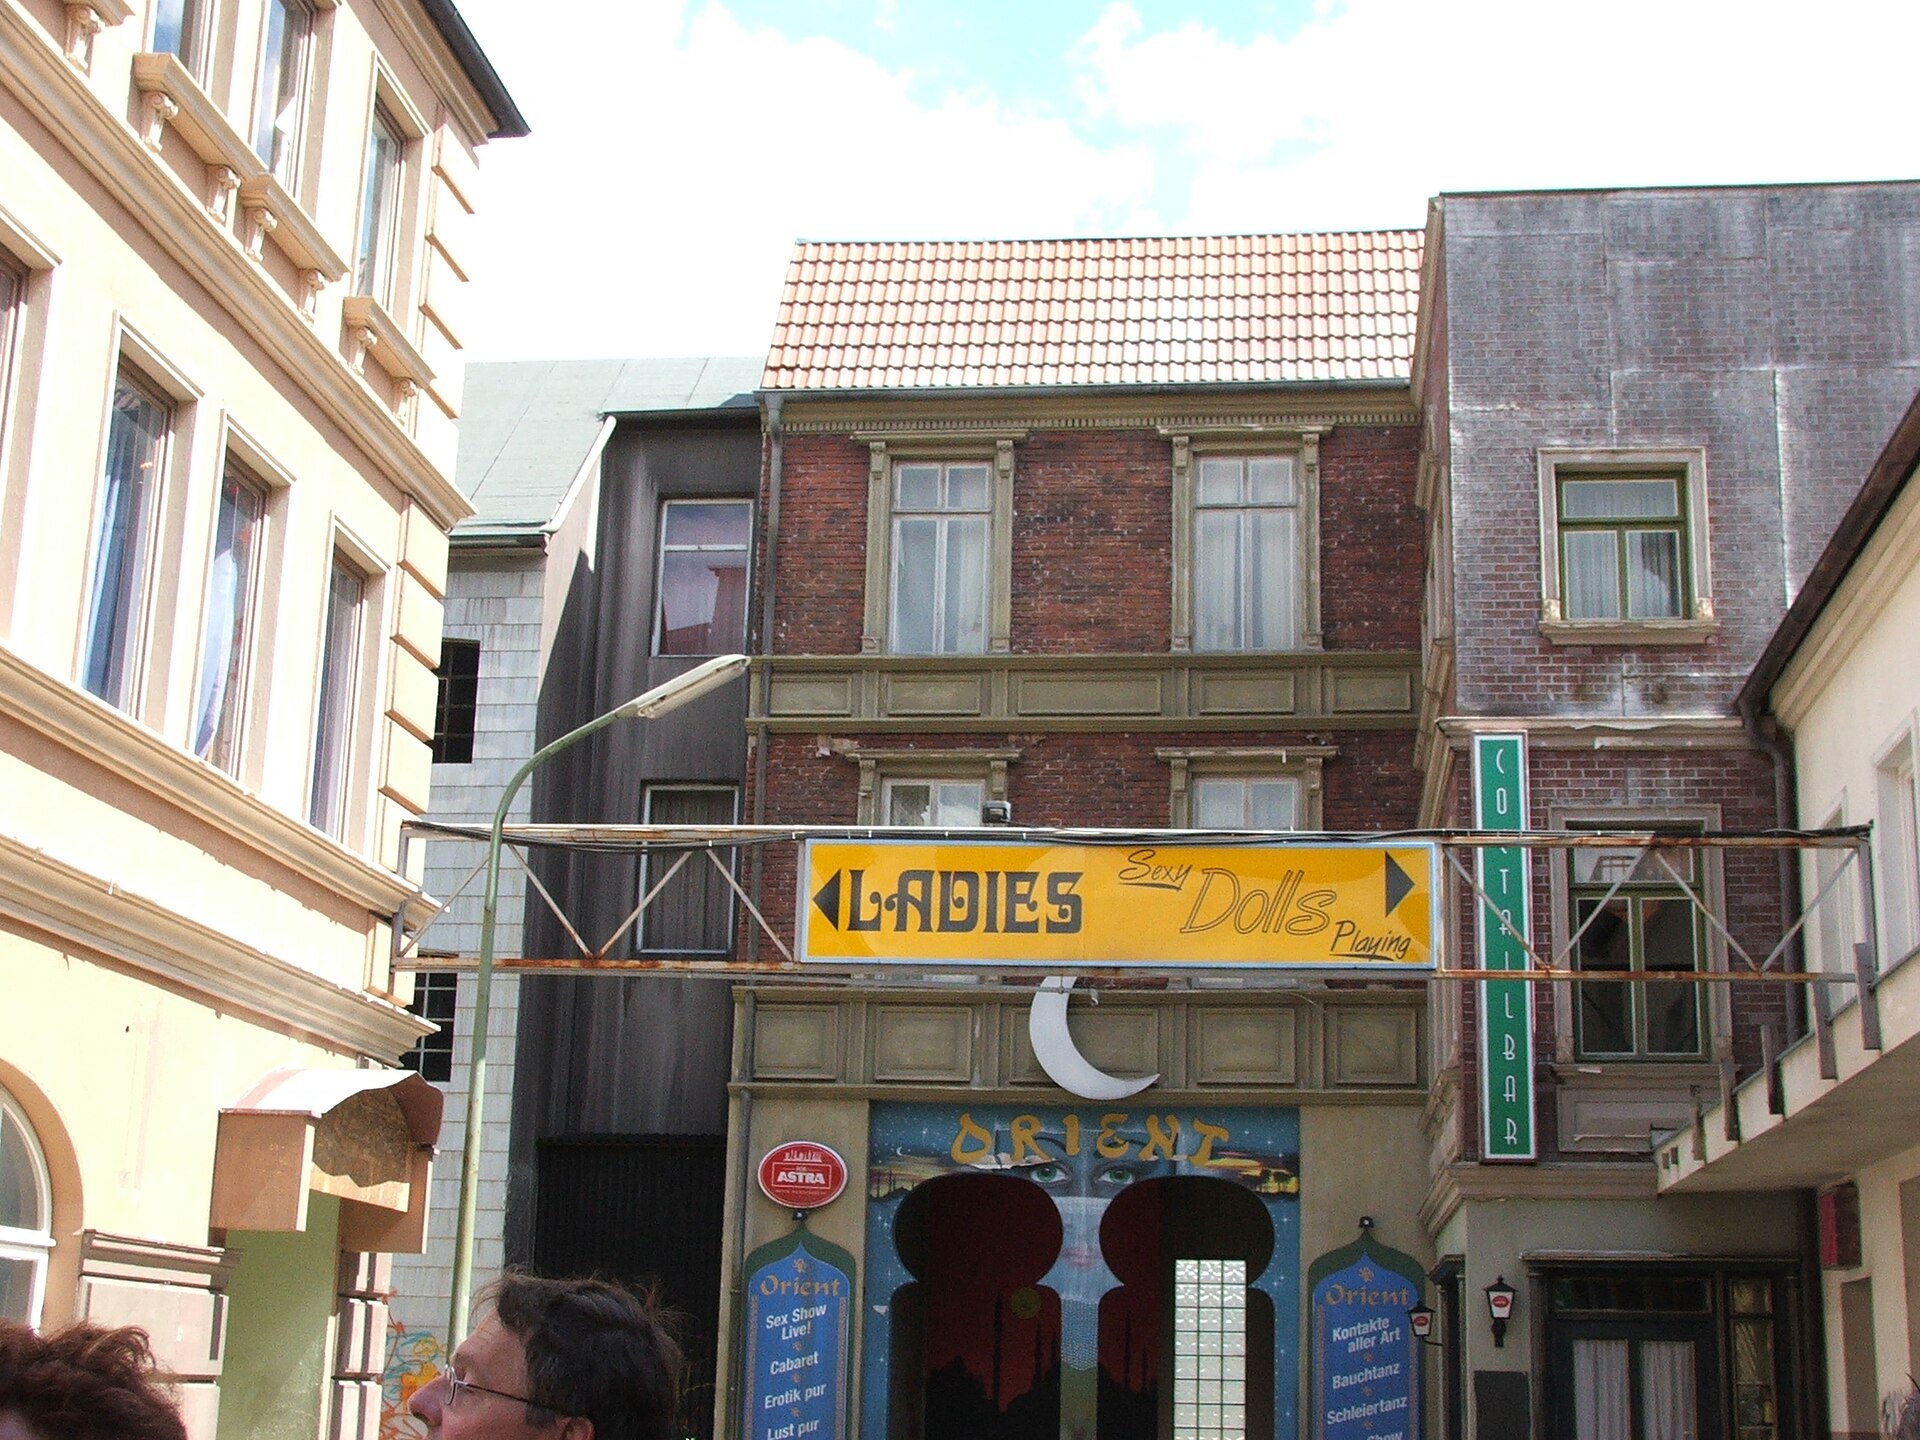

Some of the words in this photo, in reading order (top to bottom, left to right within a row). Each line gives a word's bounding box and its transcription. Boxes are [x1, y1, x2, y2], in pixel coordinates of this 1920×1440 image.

[1118, 849, 1193, 884] Sexy
[846, 869, 1084, 933] LADIES
[1180, 867, 1337, 936] Dolls
[1331, 920, 1412, 961] Playing
[1496, 748, 1518, 1145] COTAILBAR
[951, 1113, 1230, 1167] ORIENT
[777, 1171, 826, 1185] ASTRA
[760, 1274, 840, 1297] Orient
[1325, 1283, 1409, 1306] Orient
[766, 1314, 788, 1329] Sex
[792, 1304, 827, 1322] Show
[781, 1321, 811, 1340] Live!
[1332, 1317, 1390, 1342] Kontakte
[1347, 1335, 1377, 1353] aller
[1379, 1327, 1401, 1345] Art
[770, 1351, 819, 1375] Cabaret
[1332, 1362, 1400, 1389] Bauchtanz
[764, 1388, 801, 1409] Erotik
[804, 1384, 827, 1402] pur
[1327, 1396, 1408, 1425] Schleiertanz
[767, 1423, 794, 1440] Lust
[798, 1419, 820, 1438] pur
